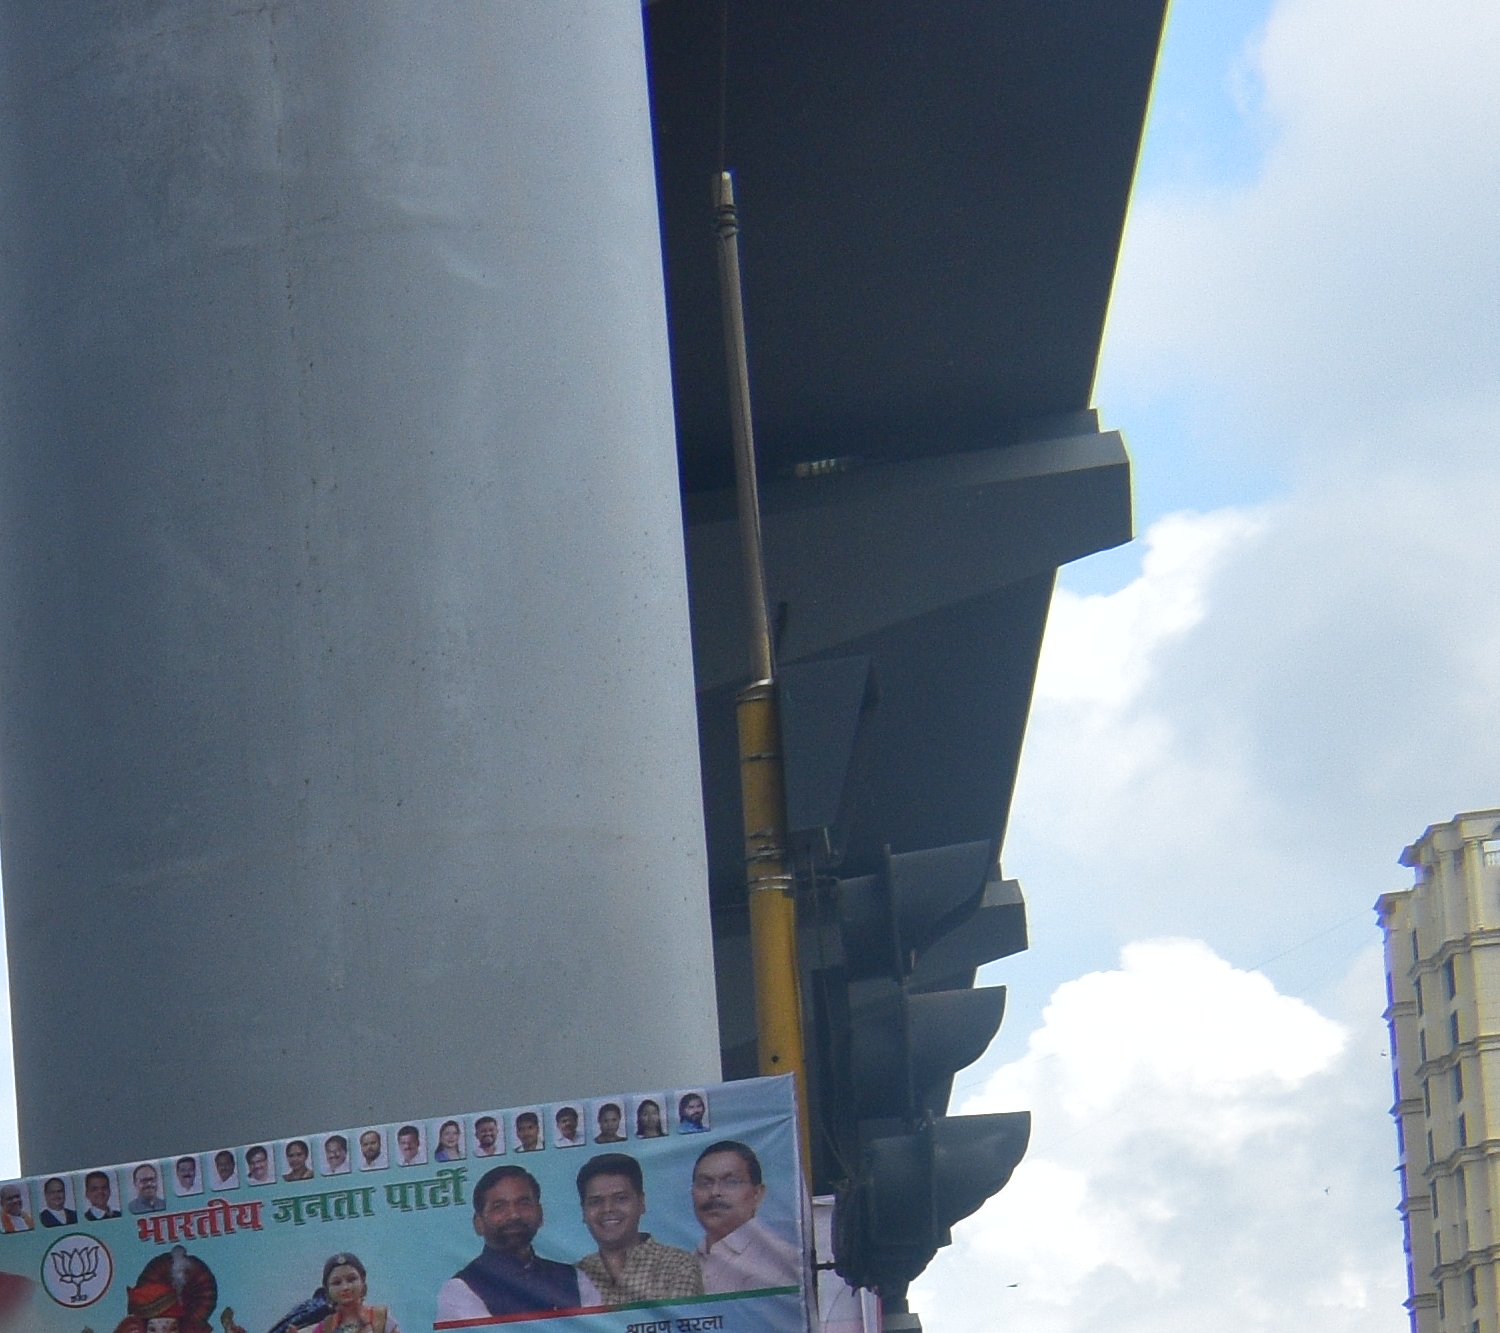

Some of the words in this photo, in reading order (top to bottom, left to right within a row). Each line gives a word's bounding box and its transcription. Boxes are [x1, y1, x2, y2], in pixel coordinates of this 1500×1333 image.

[137, 1198, 264, 1245] भारतीय
[271, 1187, 375, 1225] जनता
[384, 1167, 468, 1211] पार्टी
[676, 1315, 724, 1332] सरला
